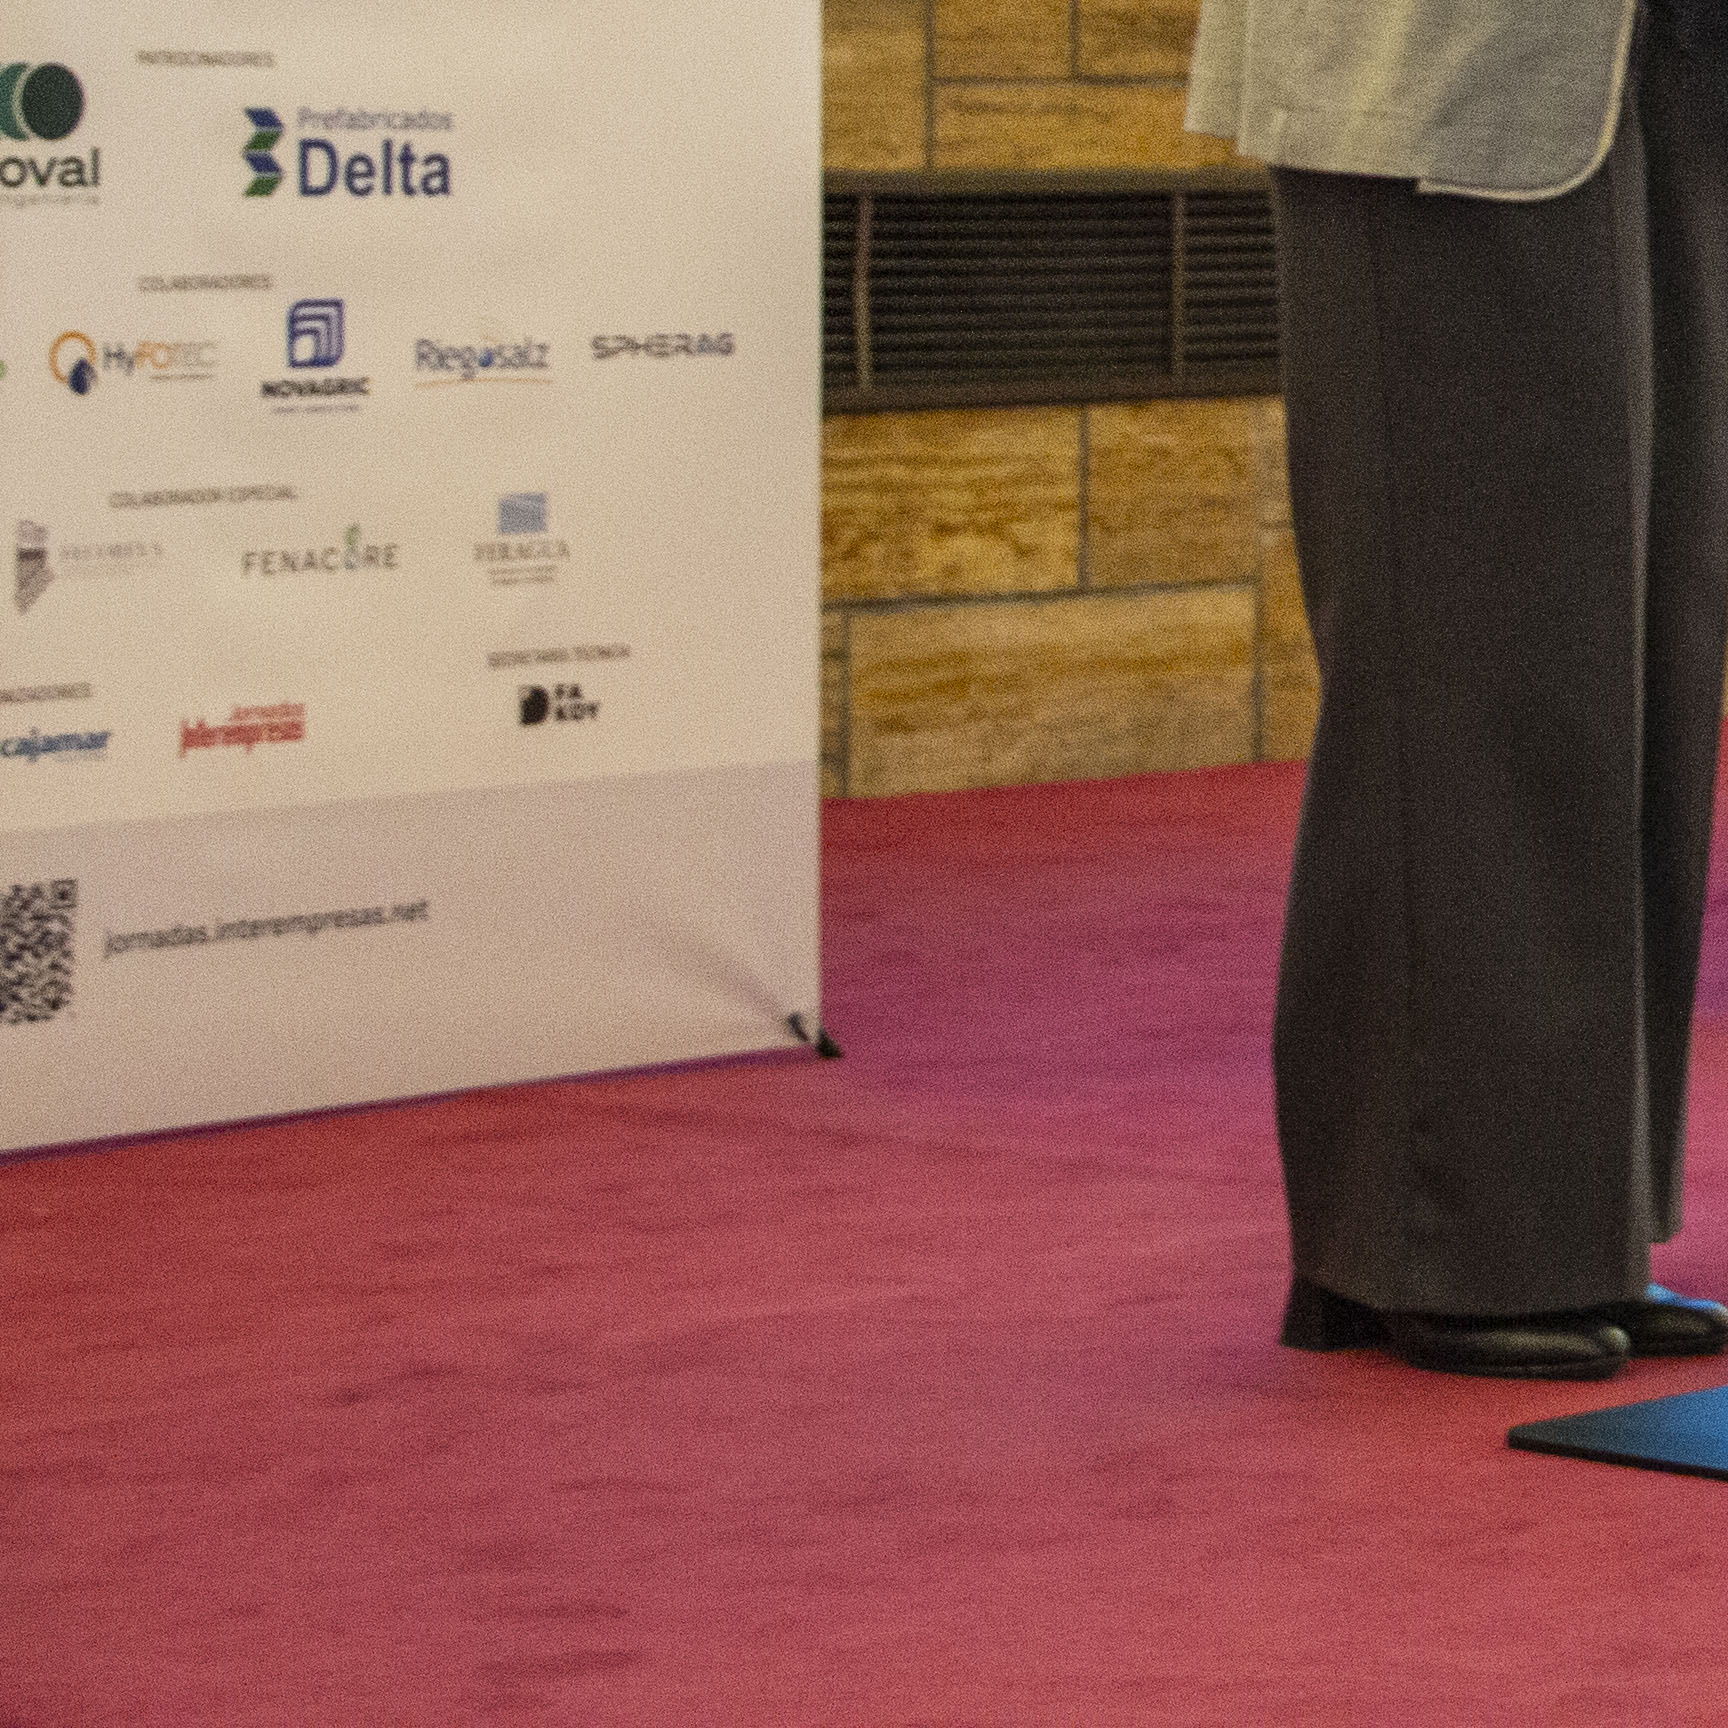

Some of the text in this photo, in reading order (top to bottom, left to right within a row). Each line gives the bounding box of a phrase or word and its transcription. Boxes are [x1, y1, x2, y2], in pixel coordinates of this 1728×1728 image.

[297, 107, 454, 132] Prefabricados
[297, 138, 452, 198] Delta
[102, 898, 429, 962] jornadas.interempresas.net
